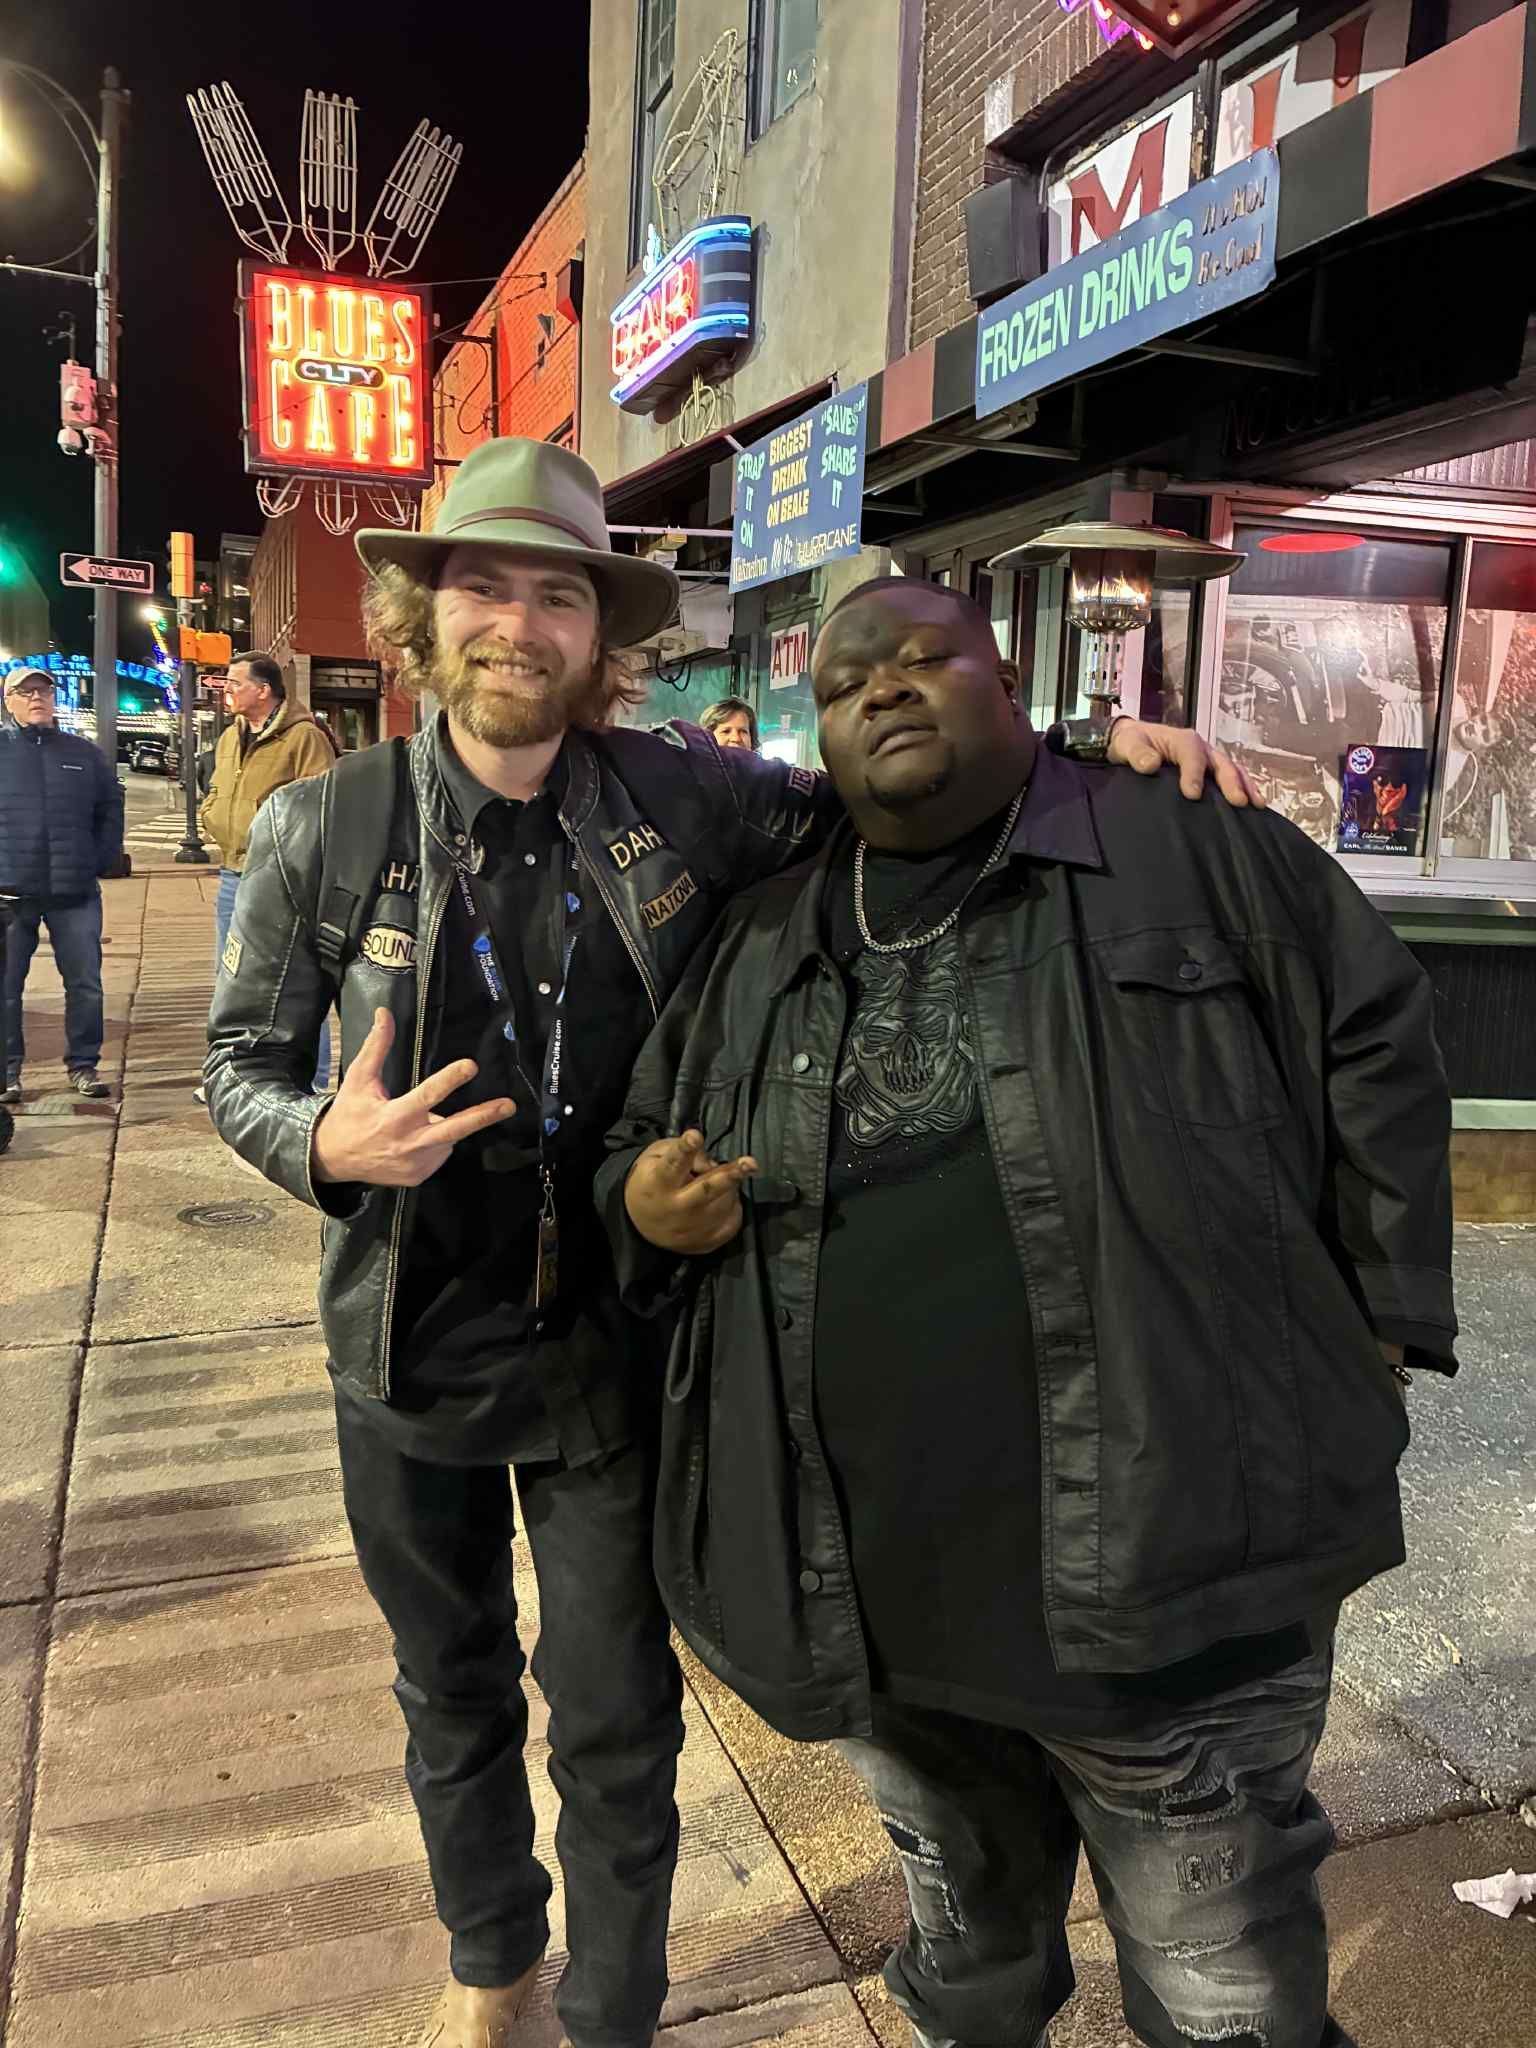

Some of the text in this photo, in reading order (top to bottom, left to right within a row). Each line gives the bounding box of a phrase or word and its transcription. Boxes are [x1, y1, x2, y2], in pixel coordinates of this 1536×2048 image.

[979, 219, 1194, 388] FROZEN DRINKS
[267, 282, 416, 366] BLUES
[301, 361, 377, 385] CITY
[270, 358, 415, 465] CAFE
[769, 419, 813, 466] BIGGEST
[821, 444, 857, 478] SHARE
[738, 451, 765, 483] STRAP
[771, 456, 808, 496] DRINK
[745, 486, 754, 511] IT
[767, 488, 810, 528] ON BEALE
[831, 479, 842, 509] IT
[740, 520, 754, 548] ON
[89, 565, 142, 581] ONE WAY
[0, 652, 64, 677] OME
[115, 659, 172, 688] LUES
[771, 632, 807, 680] ATM
[478, 954, 500, 1001] FOUNDATION
[550, 1019, 562, 1094] BluesCruise.com
